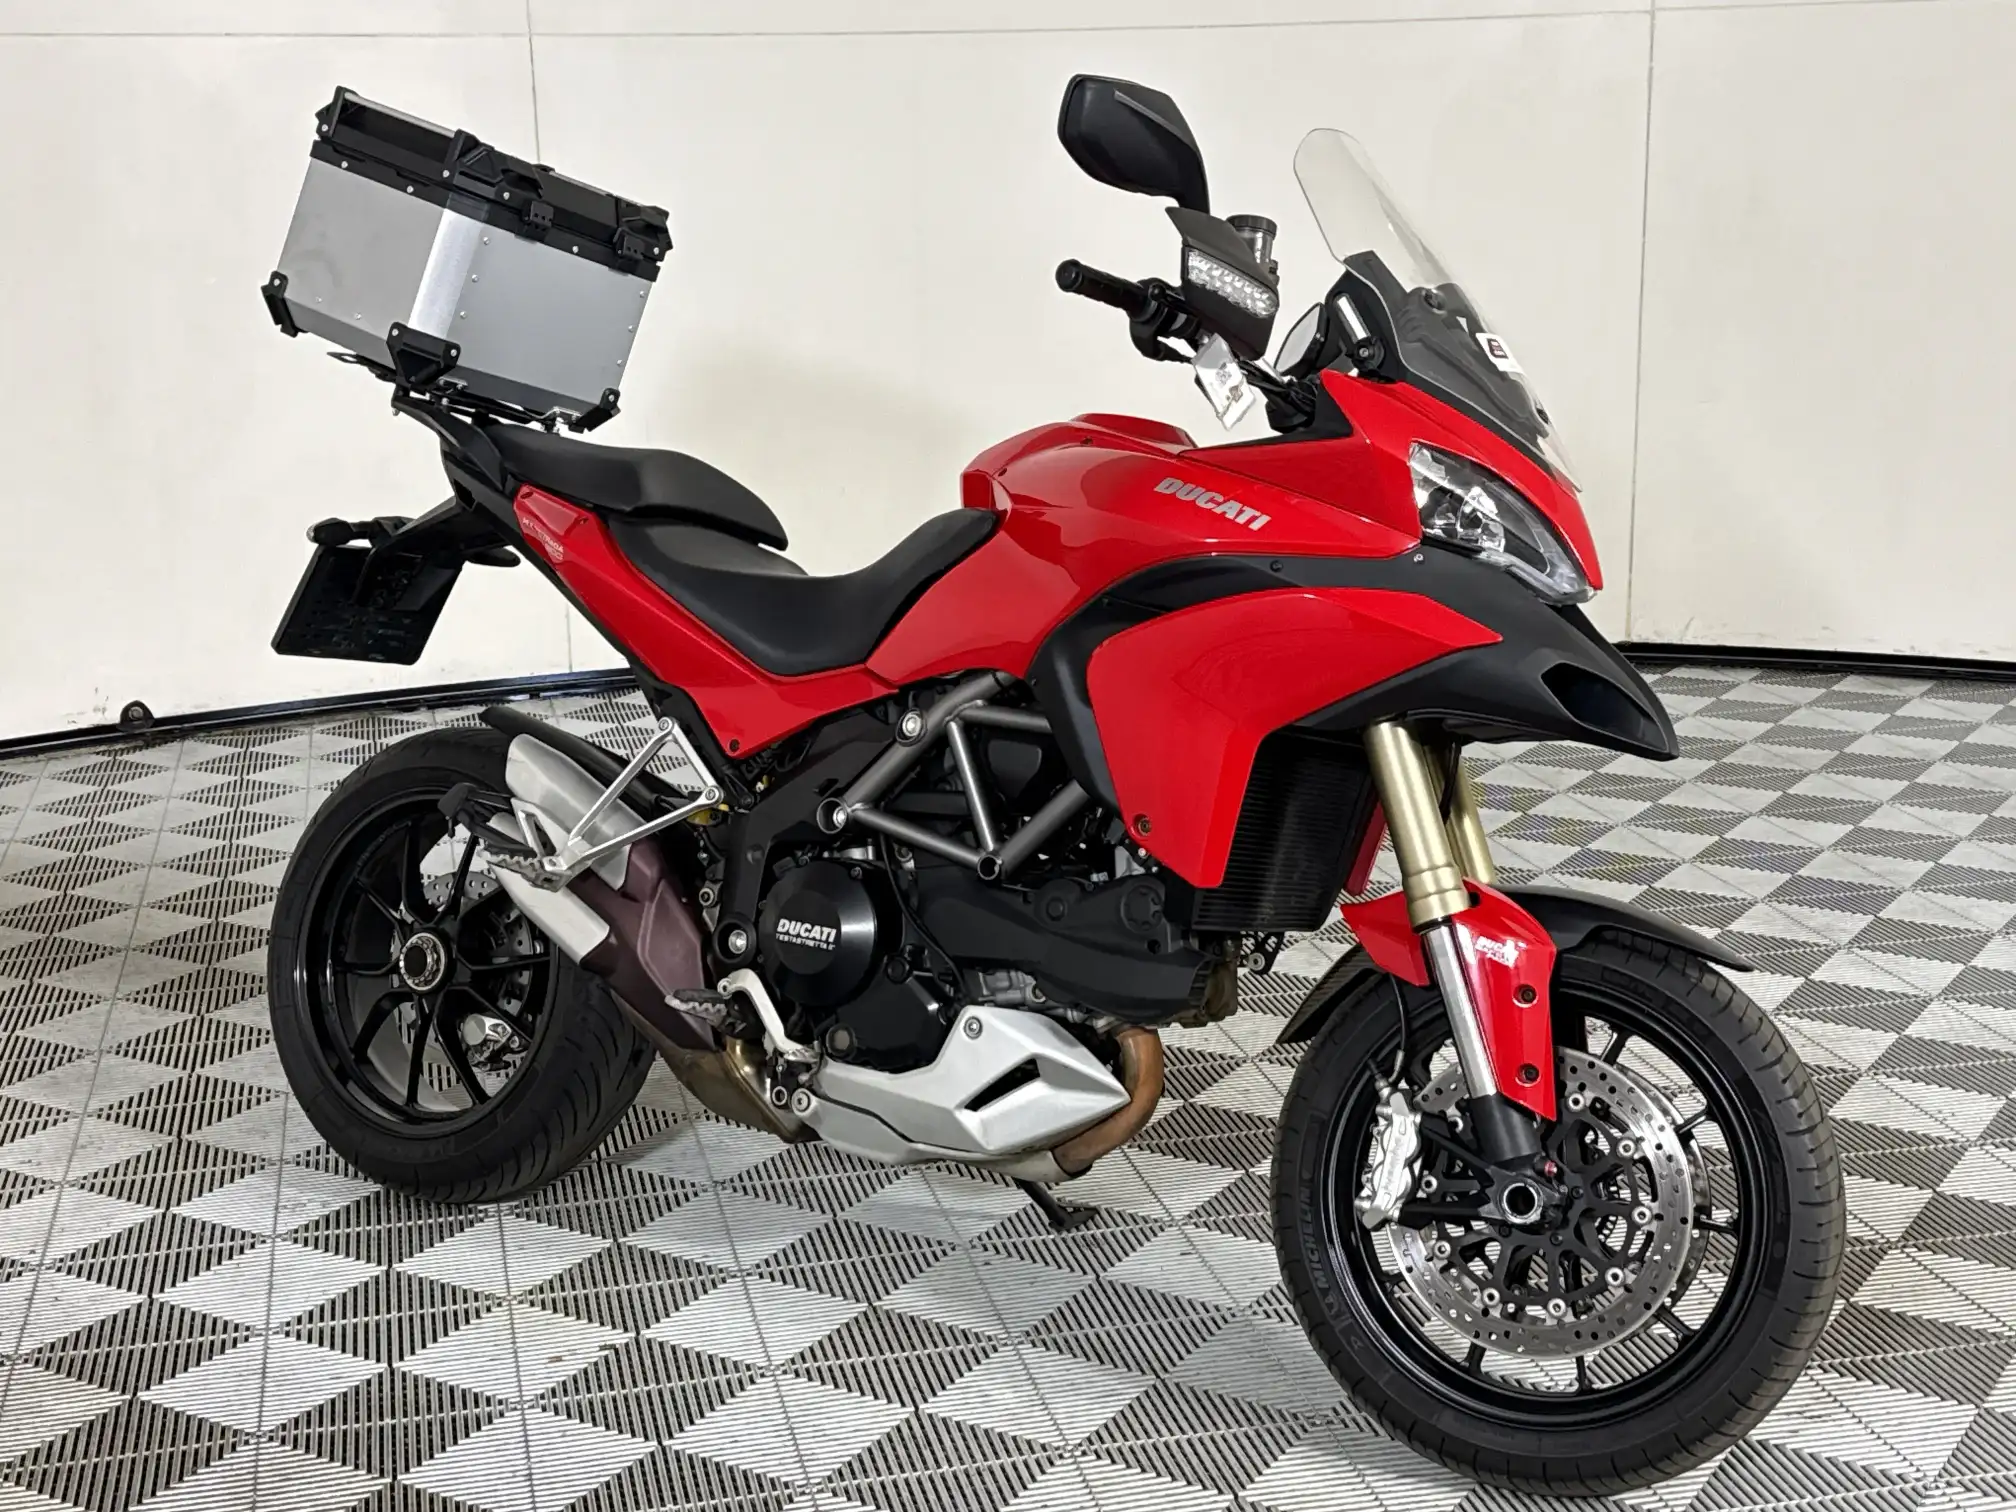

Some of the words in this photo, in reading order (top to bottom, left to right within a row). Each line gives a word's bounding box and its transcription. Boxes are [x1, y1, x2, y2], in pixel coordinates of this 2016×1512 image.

[1153, 477, 1272, 531] DUCATI
[776, 918, 837, 943] DUCATI
[1300, 1186, 1330, 1289] MICHELIN
